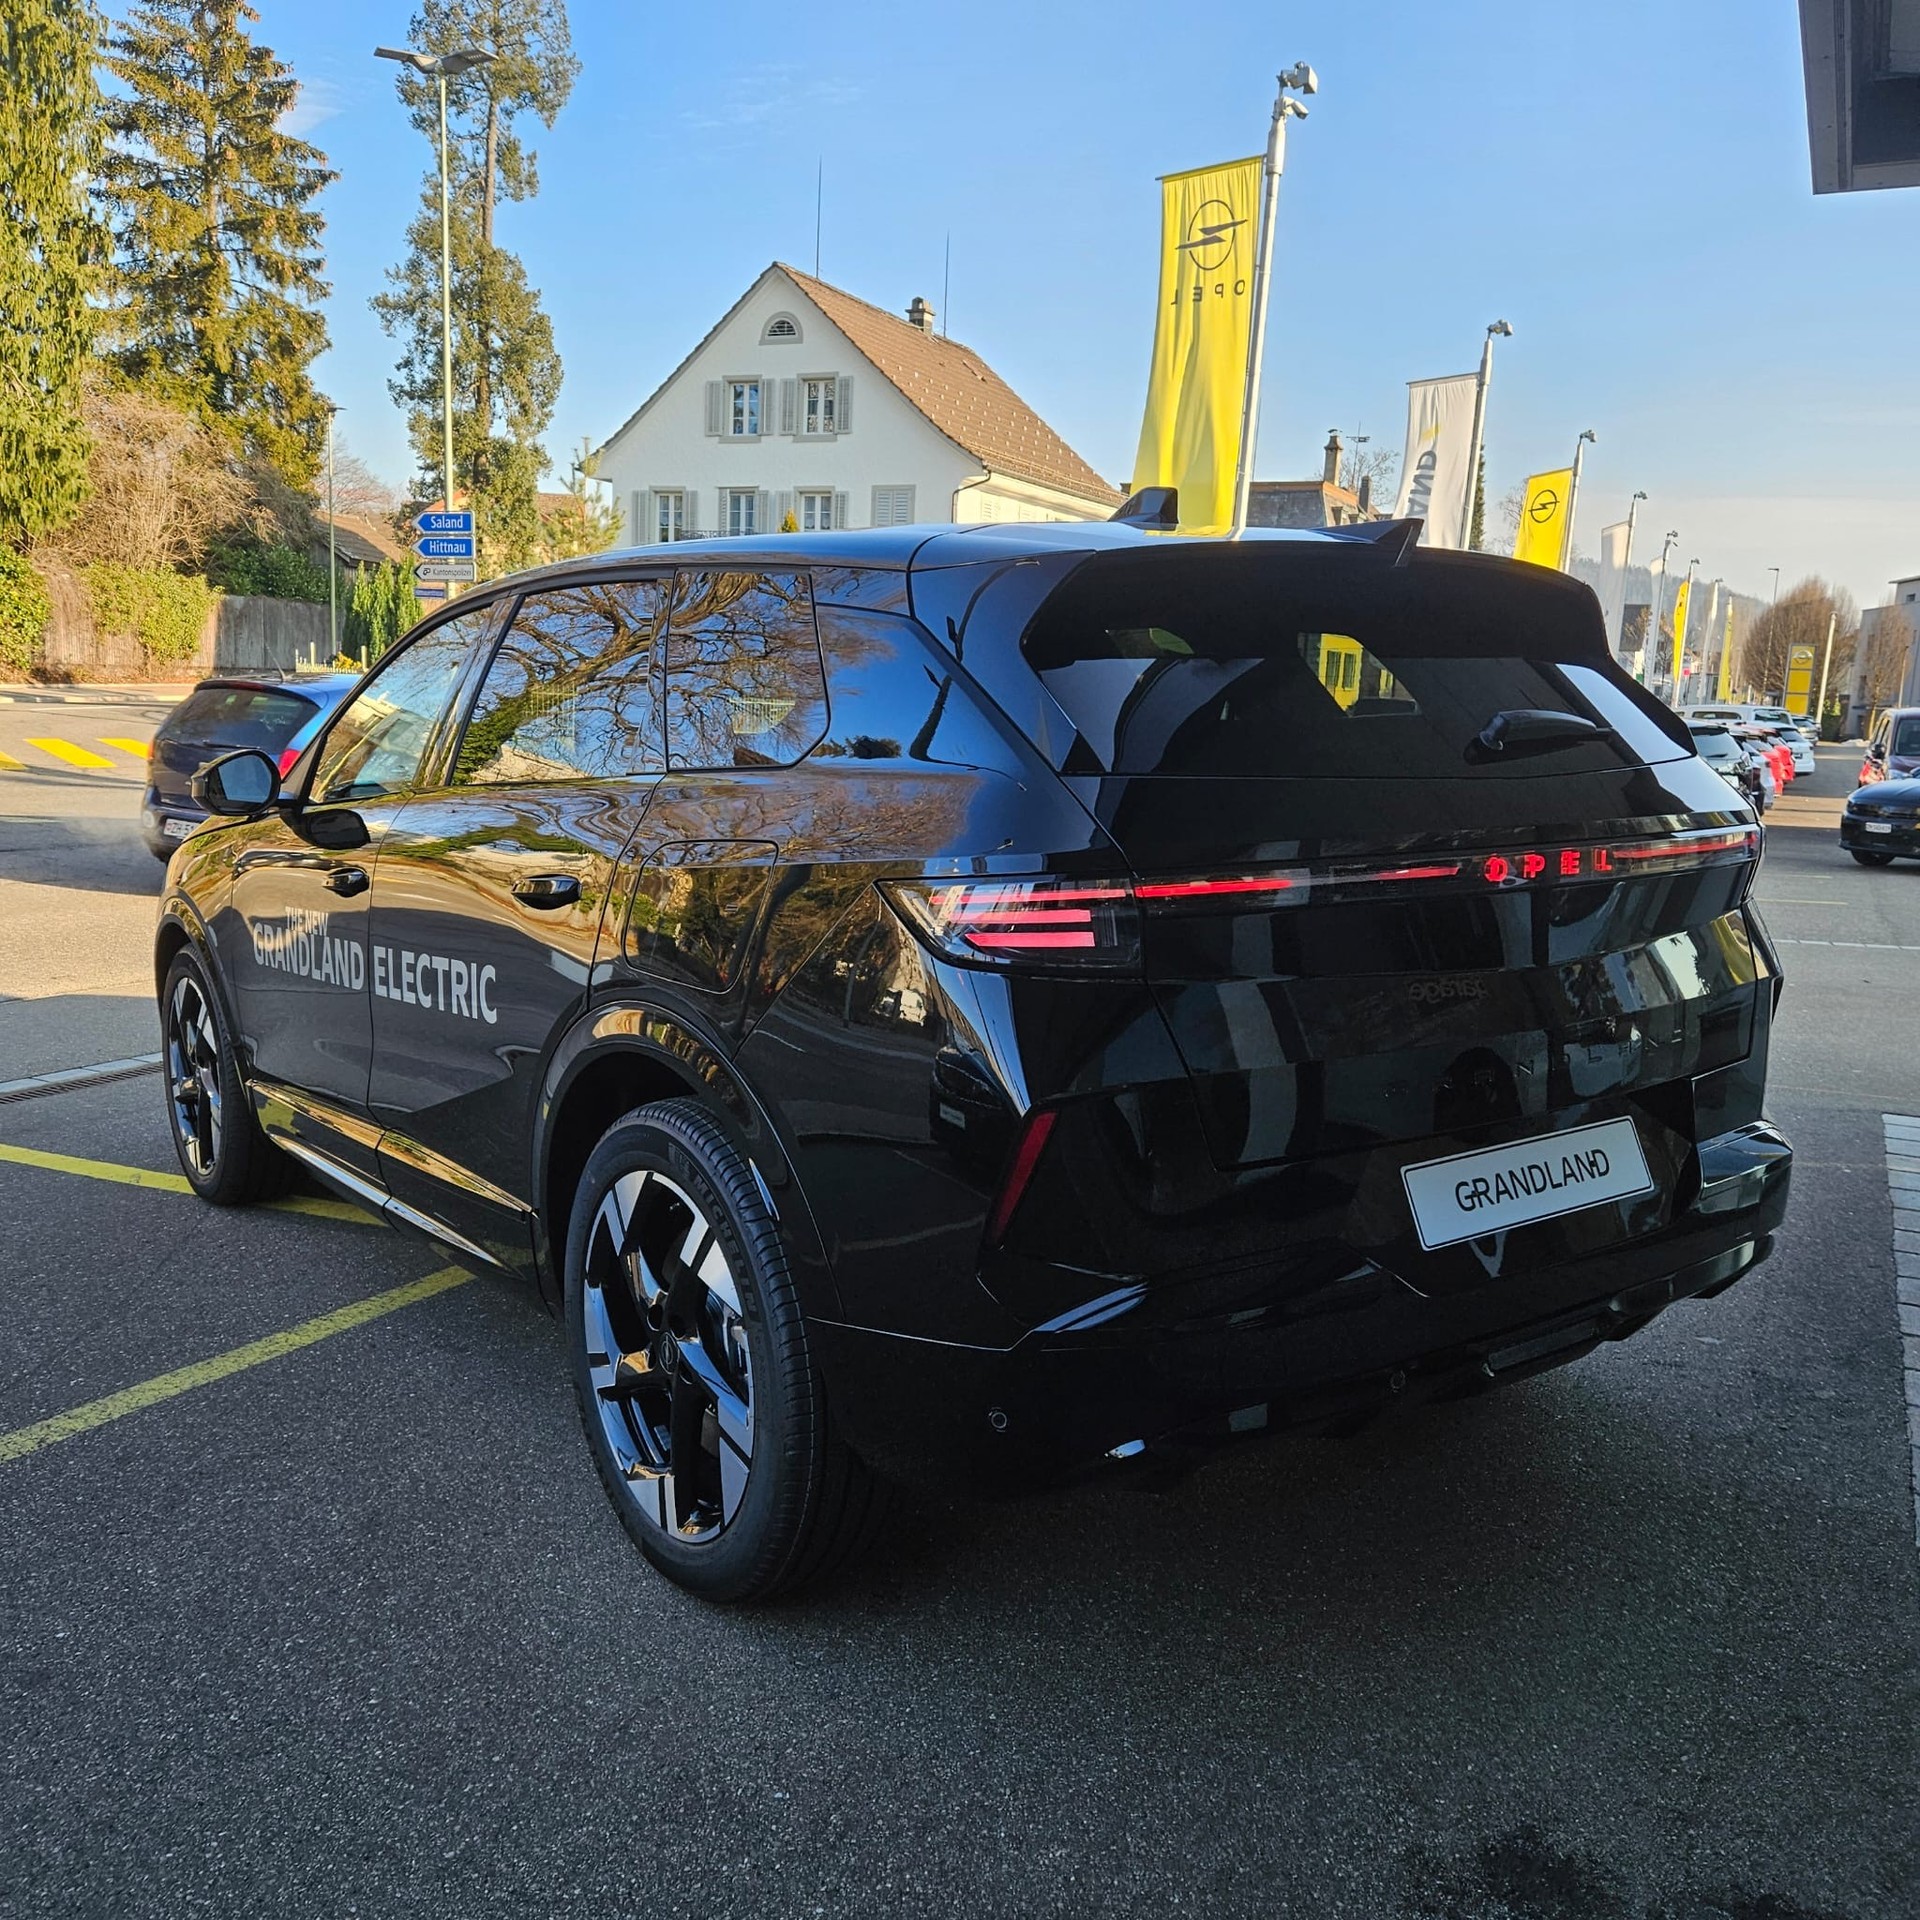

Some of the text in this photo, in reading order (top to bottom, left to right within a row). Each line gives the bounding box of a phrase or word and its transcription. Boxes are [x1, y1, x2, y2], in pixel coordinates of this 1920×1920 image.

[430, 515, 464, 529] Saland
[429, 540, 466, 553] Hittnau
[1484, 848, 1613, 883] OPEL
[285, 906, 329, 937] THE NEW
[253, 922, 498, 1025] GRANDLAND ELECTRIC
[1454, 1148, 1610, 1213] GRANDLAND
[693, 1173, 758, 1315] MICHELIN
